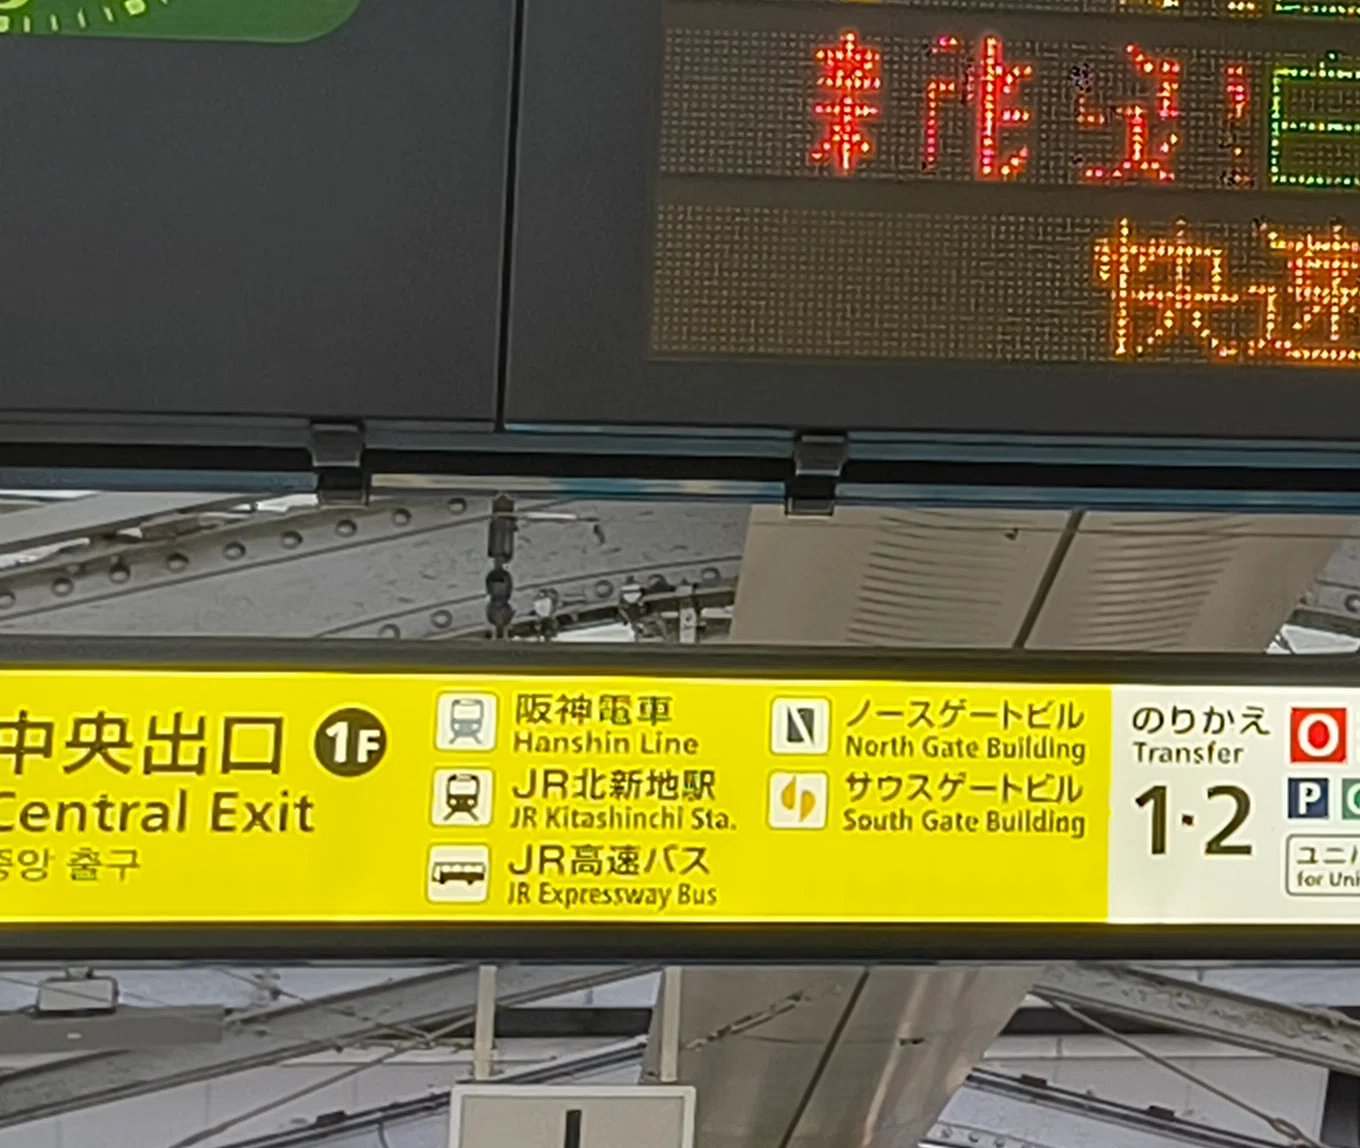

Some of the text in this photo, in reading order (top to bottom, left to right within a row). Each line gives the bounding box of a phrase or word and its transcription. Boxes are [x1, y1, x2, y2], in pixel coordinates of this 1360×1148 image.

[515, 693, 674, 728] 阪神電車
[845, 698, 1085, 732] ノースゲートビル
[1131, 704, 1271, 737] のりかえ
[0, 709, 381, 776] 中央出口 1F
[513, 729, 700, 756] Hanshin Line
[845, 734, 1086, 766] North Gate Building
[1297, 711, 1341, 758] O
[1133, 740, 1244, 766] Transfer
[511, 768, 716, 803] JR北新地駅
[845, 770, 1085, 805] サウスゲートビル
[210, 789, 316, 834] Exit
[509, 806, 738, 832] JR Kitashinchi Sta.
[843, 808, 1086, 839] South Gate Building
[67, 846, 141, 883] 출구
[508, 843, 712, 878] JR高速バス
[507, 882, 718, 910] JR Expressway Bus
[1297, 870, 1323, 888] for
